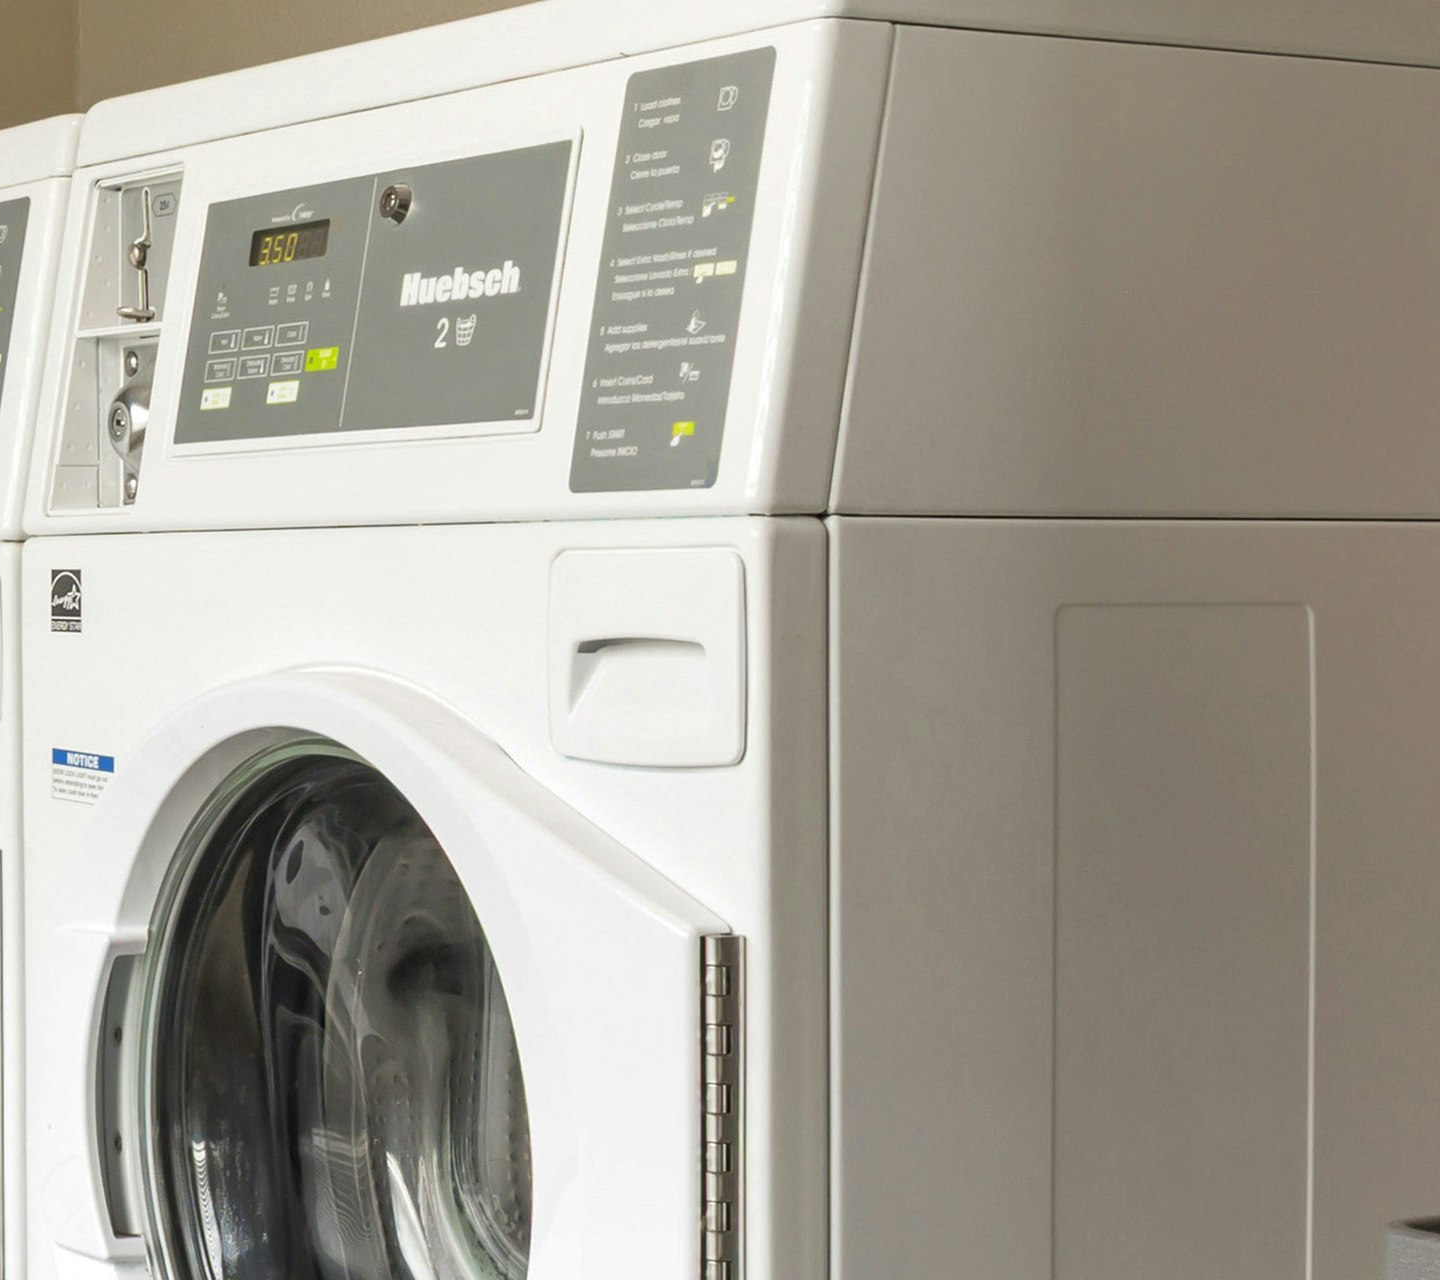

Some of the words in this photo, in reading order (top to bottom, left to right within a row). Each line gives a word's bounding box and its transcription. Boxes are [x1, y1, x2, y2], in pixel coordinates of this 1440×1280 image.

[400, 260, 520, 306] Huebsch
[434, 317, 449, 348] 2
[67, 752, 99, 769] NOTICE
